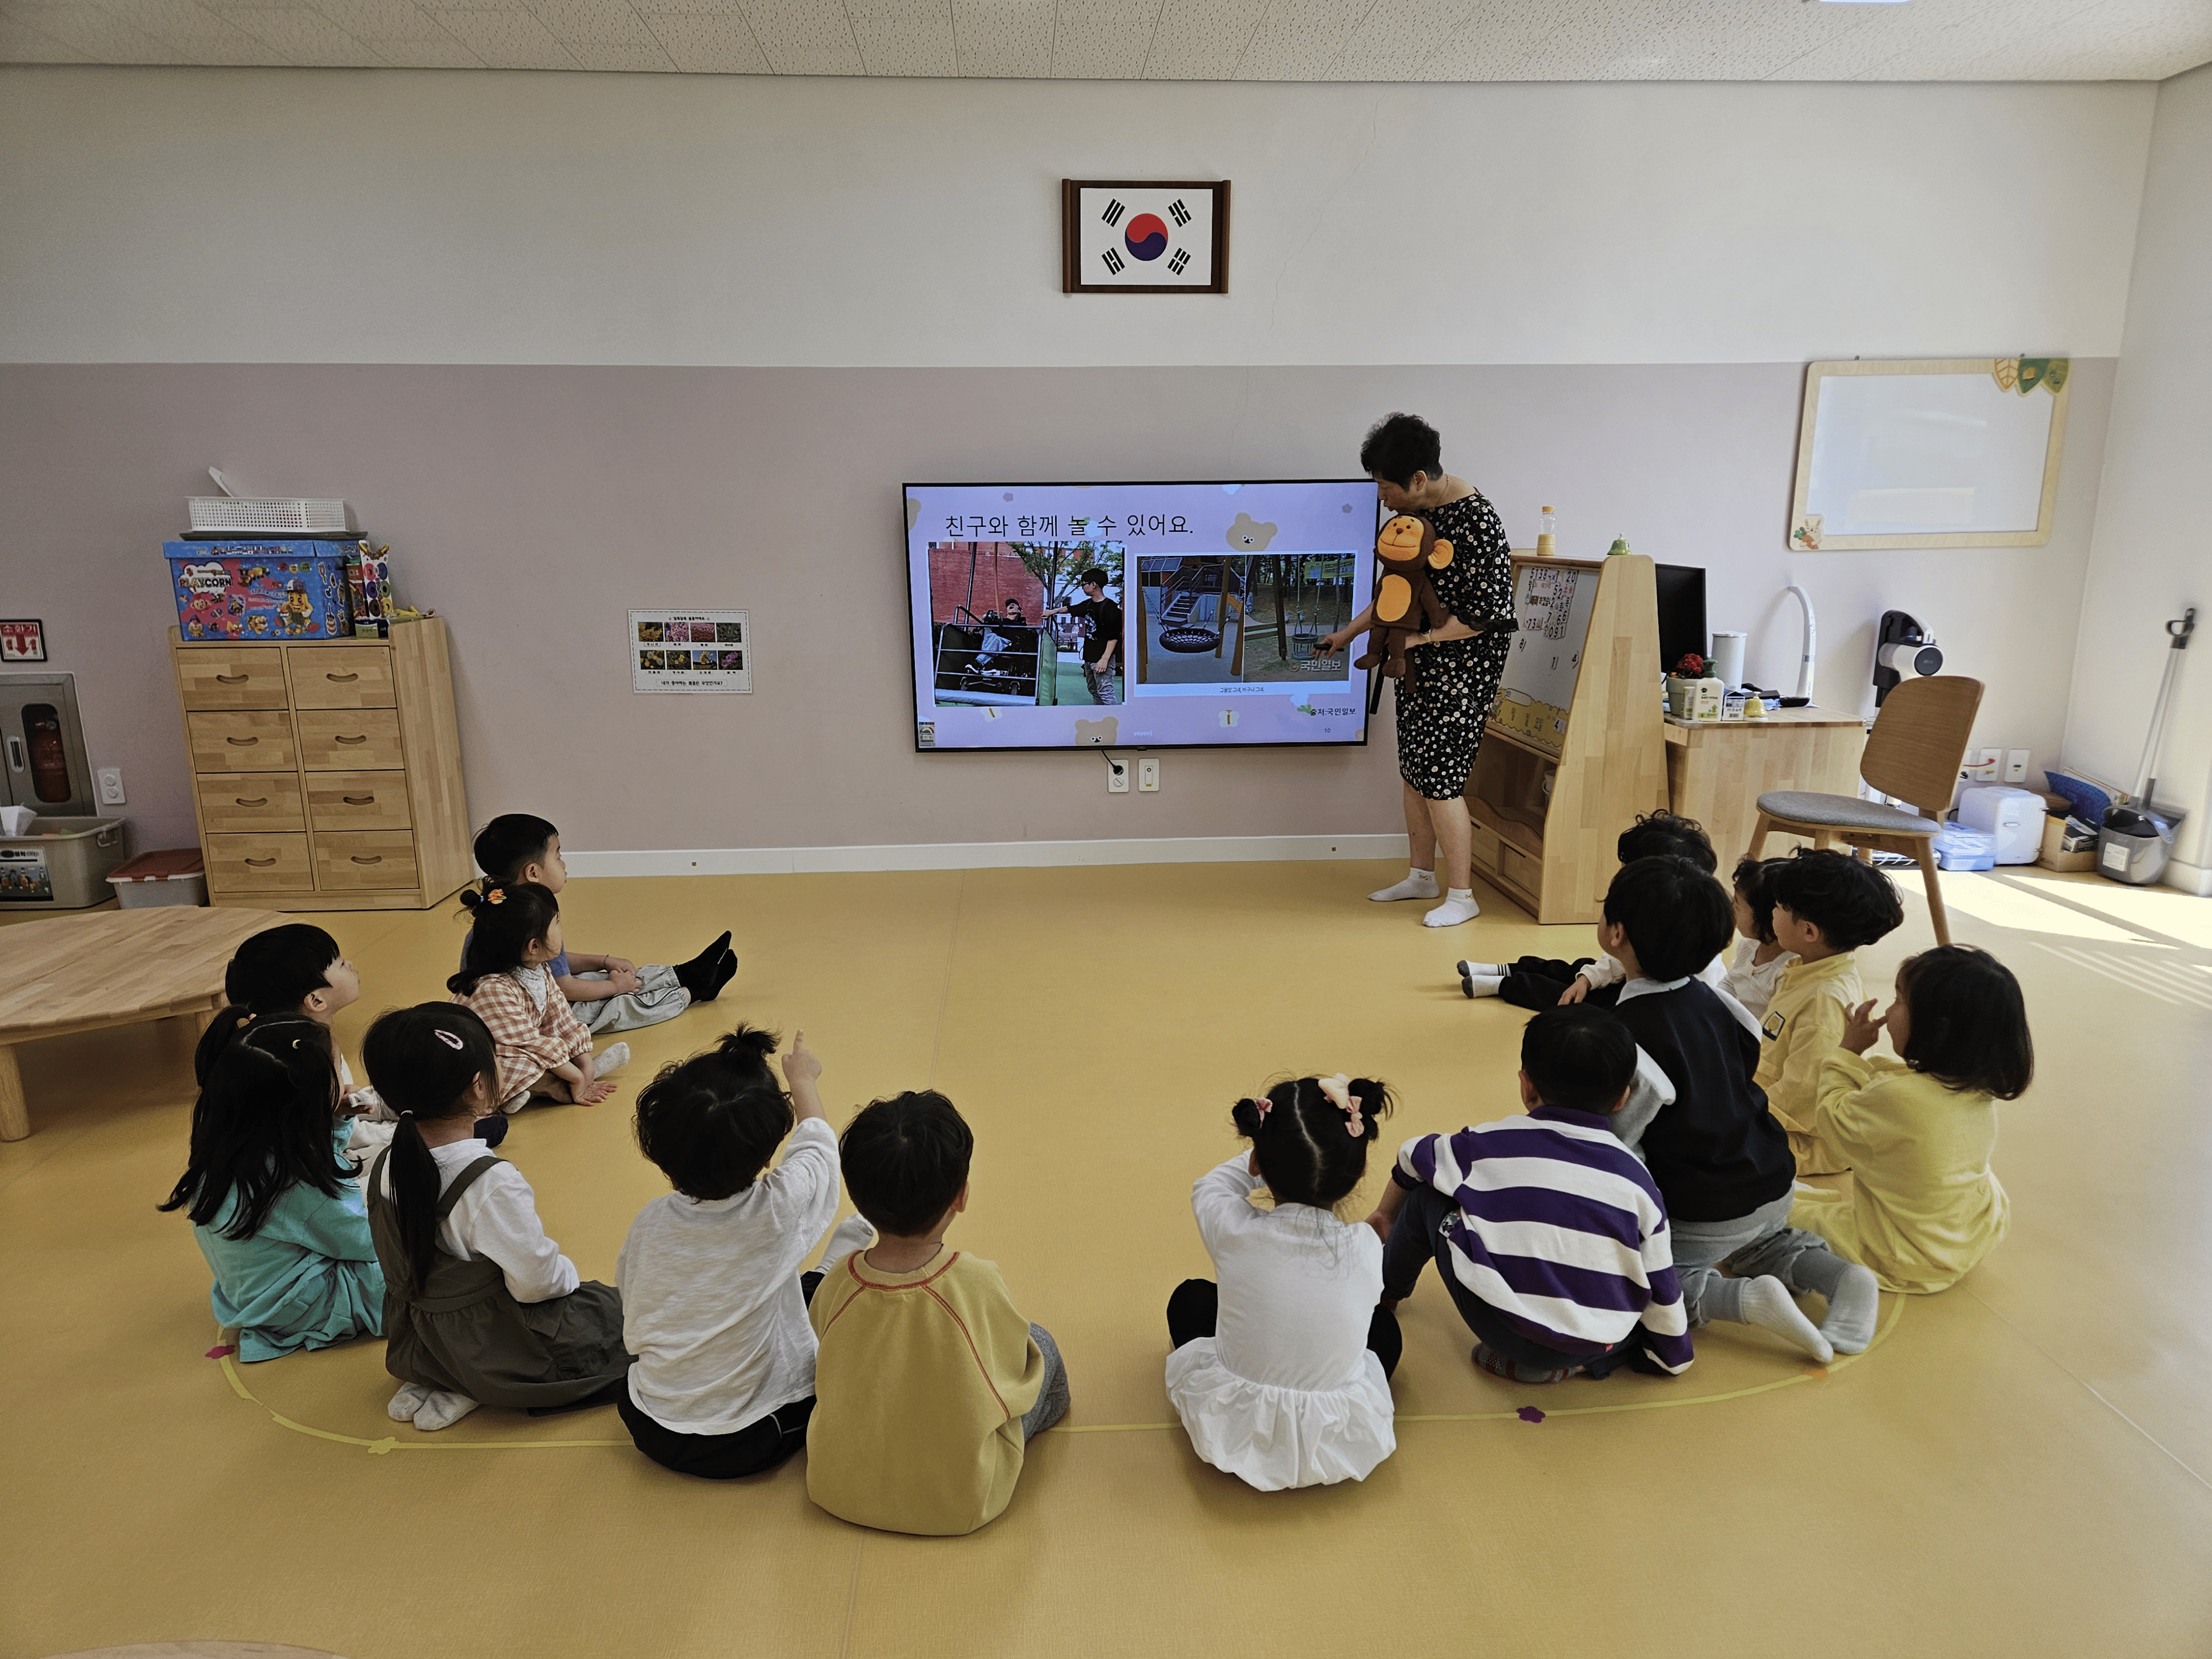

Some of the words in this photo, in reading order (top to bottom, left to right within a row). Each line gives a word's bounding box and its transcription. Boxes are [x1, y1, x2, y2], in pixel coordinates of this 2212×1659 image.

[946, 515, 1009, 537] 친구와
[1017, 514, 1058, 537] 함께
[1068, 515, 1088, 536] 놀
[1097, 515, 1117, 536] 수
[1126, 513, 1194, 536] 있어요.
[179, 577, 233, 587] PLAYCORN
[1300, 659, 1342, 672] 국민일보
